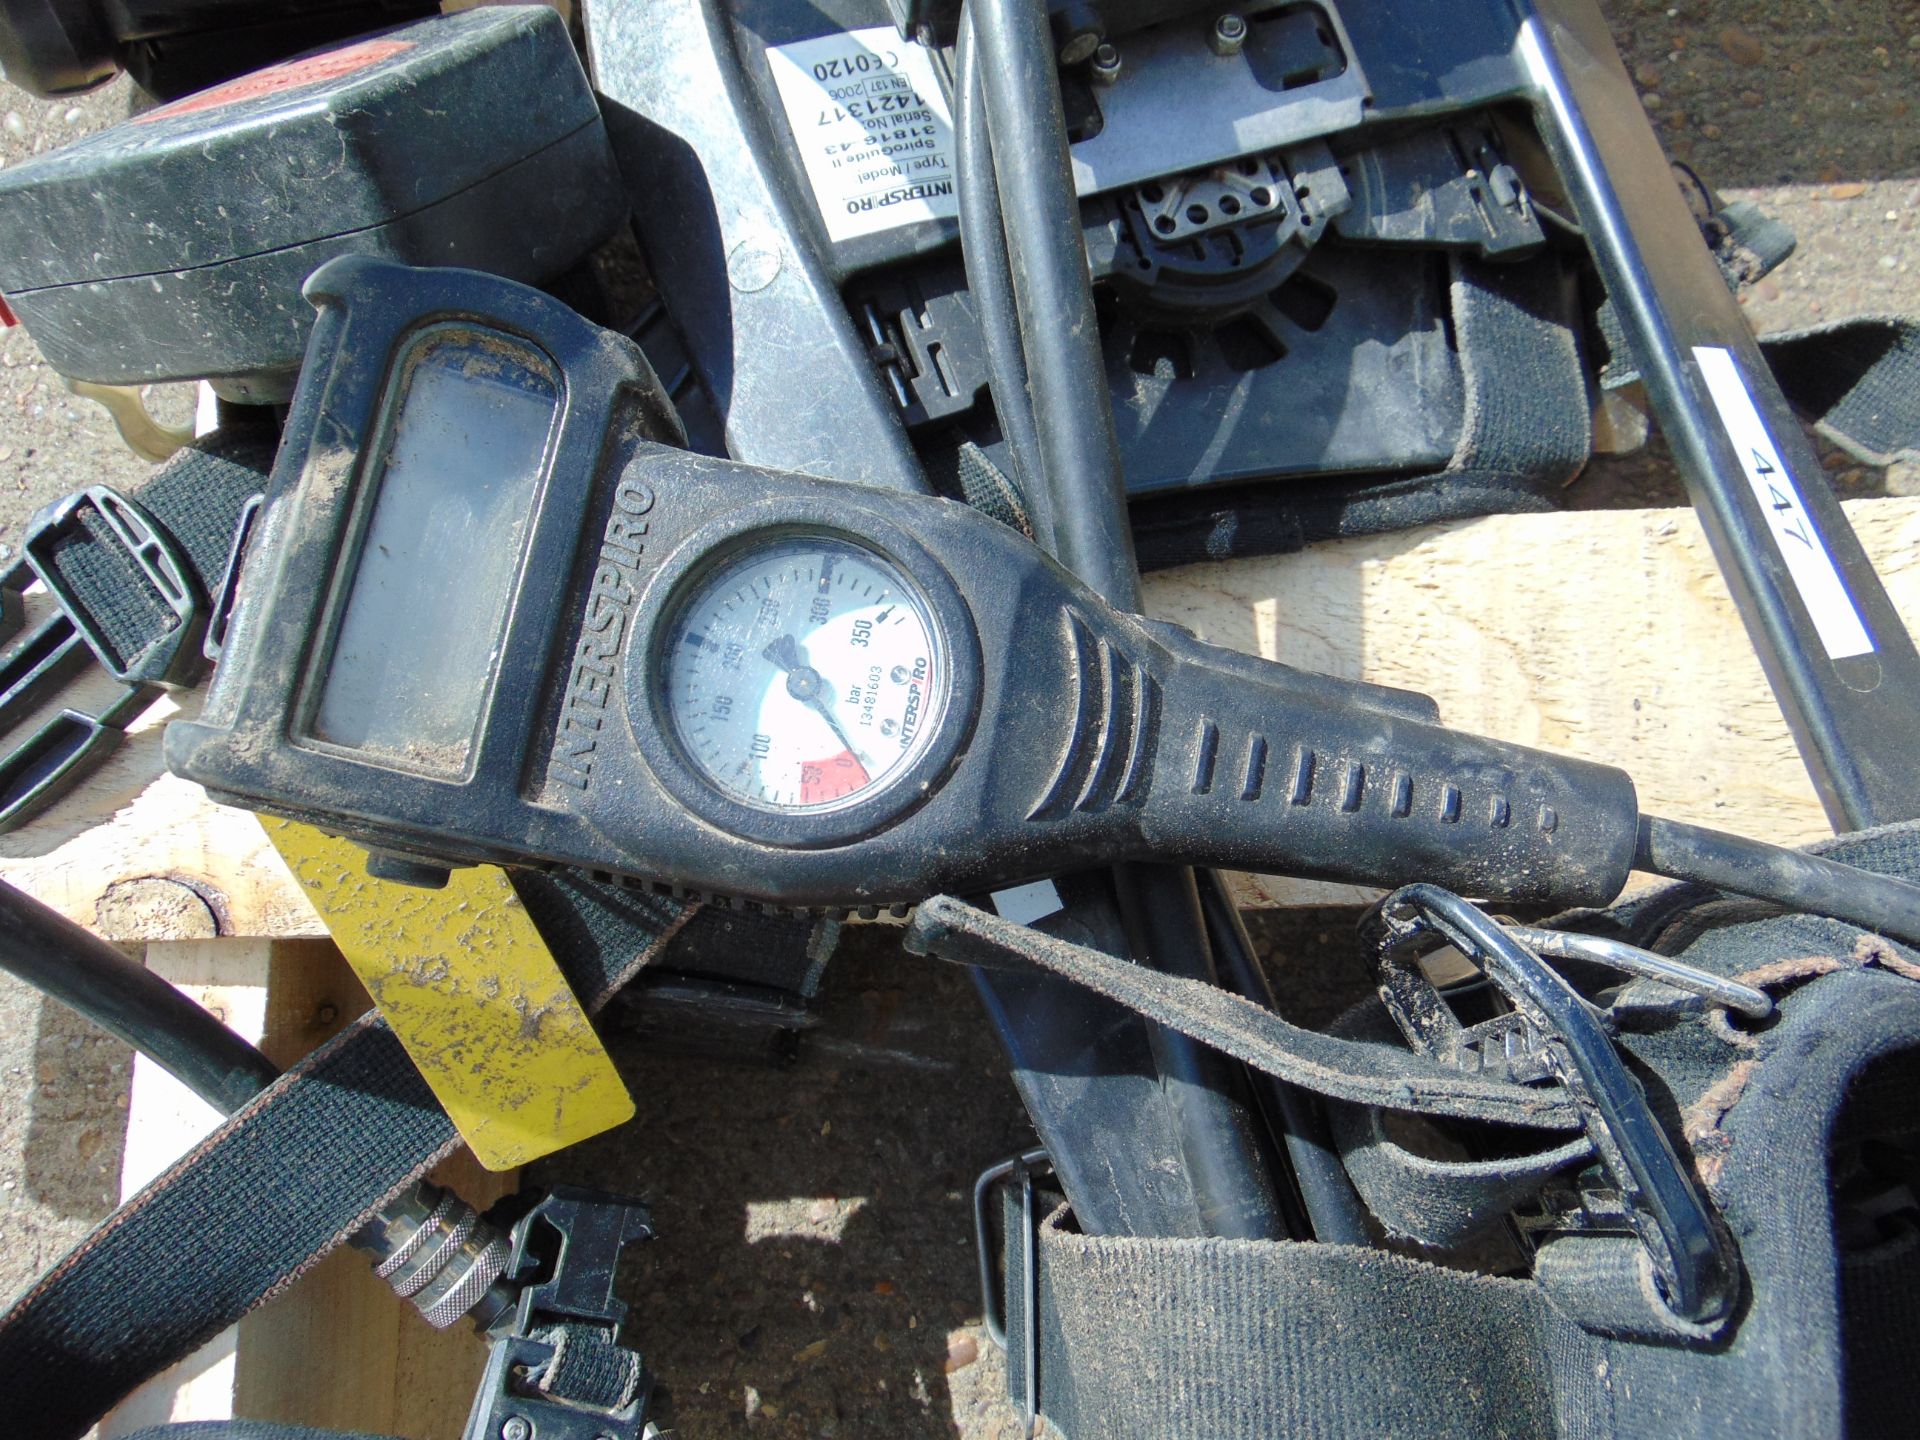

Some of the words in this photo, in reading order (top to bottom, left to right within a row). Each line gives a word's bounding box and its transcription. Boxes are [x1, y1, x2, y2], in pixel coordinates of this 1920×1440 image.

[829, 83, 864, 100] 2006
[871, 80, 890, 93] 137
[893, 77, 908, 89] EN
[817, 92, 926, 126] 1421317
[892, 110, 932, 126] Serial
[846, 139, 936, 163] SpiroGuide
[914, 156, 949, 170] Type
[857, 165, 903, 184] Model
[847, 182, 953, 214] INTERSPIRO
[1751, 447, 1813, 550] 447
[809, 596, 831, 626] 300
[548, 478, 654, 791] INTERSPIRO
[851, 619, 873, 648] 350
[844, 684, 862, 705] bar
[859, 665, 883, 727] 13481603
[899, 656, 927, 749] INTERSPIRO
[711, 694, 734, 722] 150
[749, 733, 772, 760] 100
[801, 764, 824, 785] 50
[836, 757, 854, 768] 0
